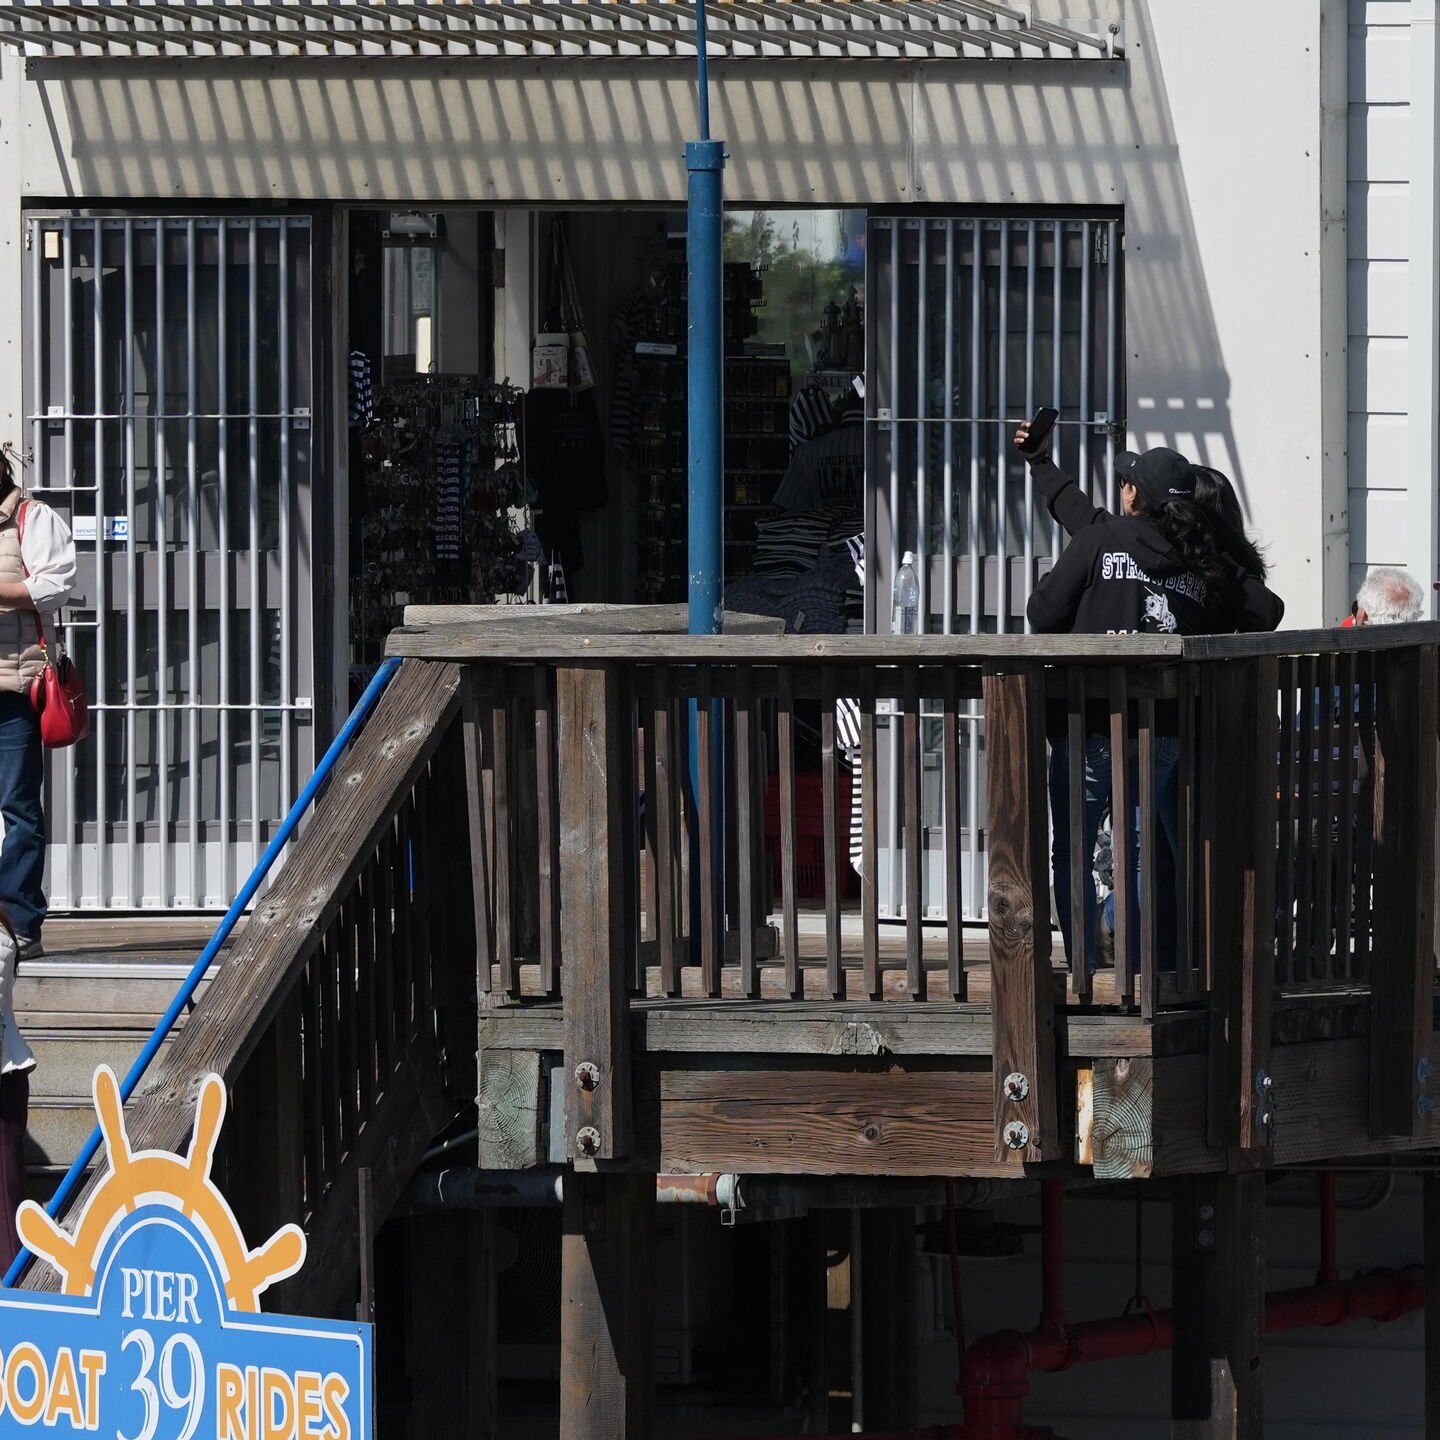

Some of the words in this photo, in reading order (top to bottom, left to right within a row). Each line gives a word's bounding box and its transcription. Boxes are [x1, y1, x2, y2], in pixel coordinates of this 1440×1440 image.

[120, 1267, 203, 1325] PIER
[116, 1328, 206, 1440] 39
[216, 1362, 352, 1440] RIDES
